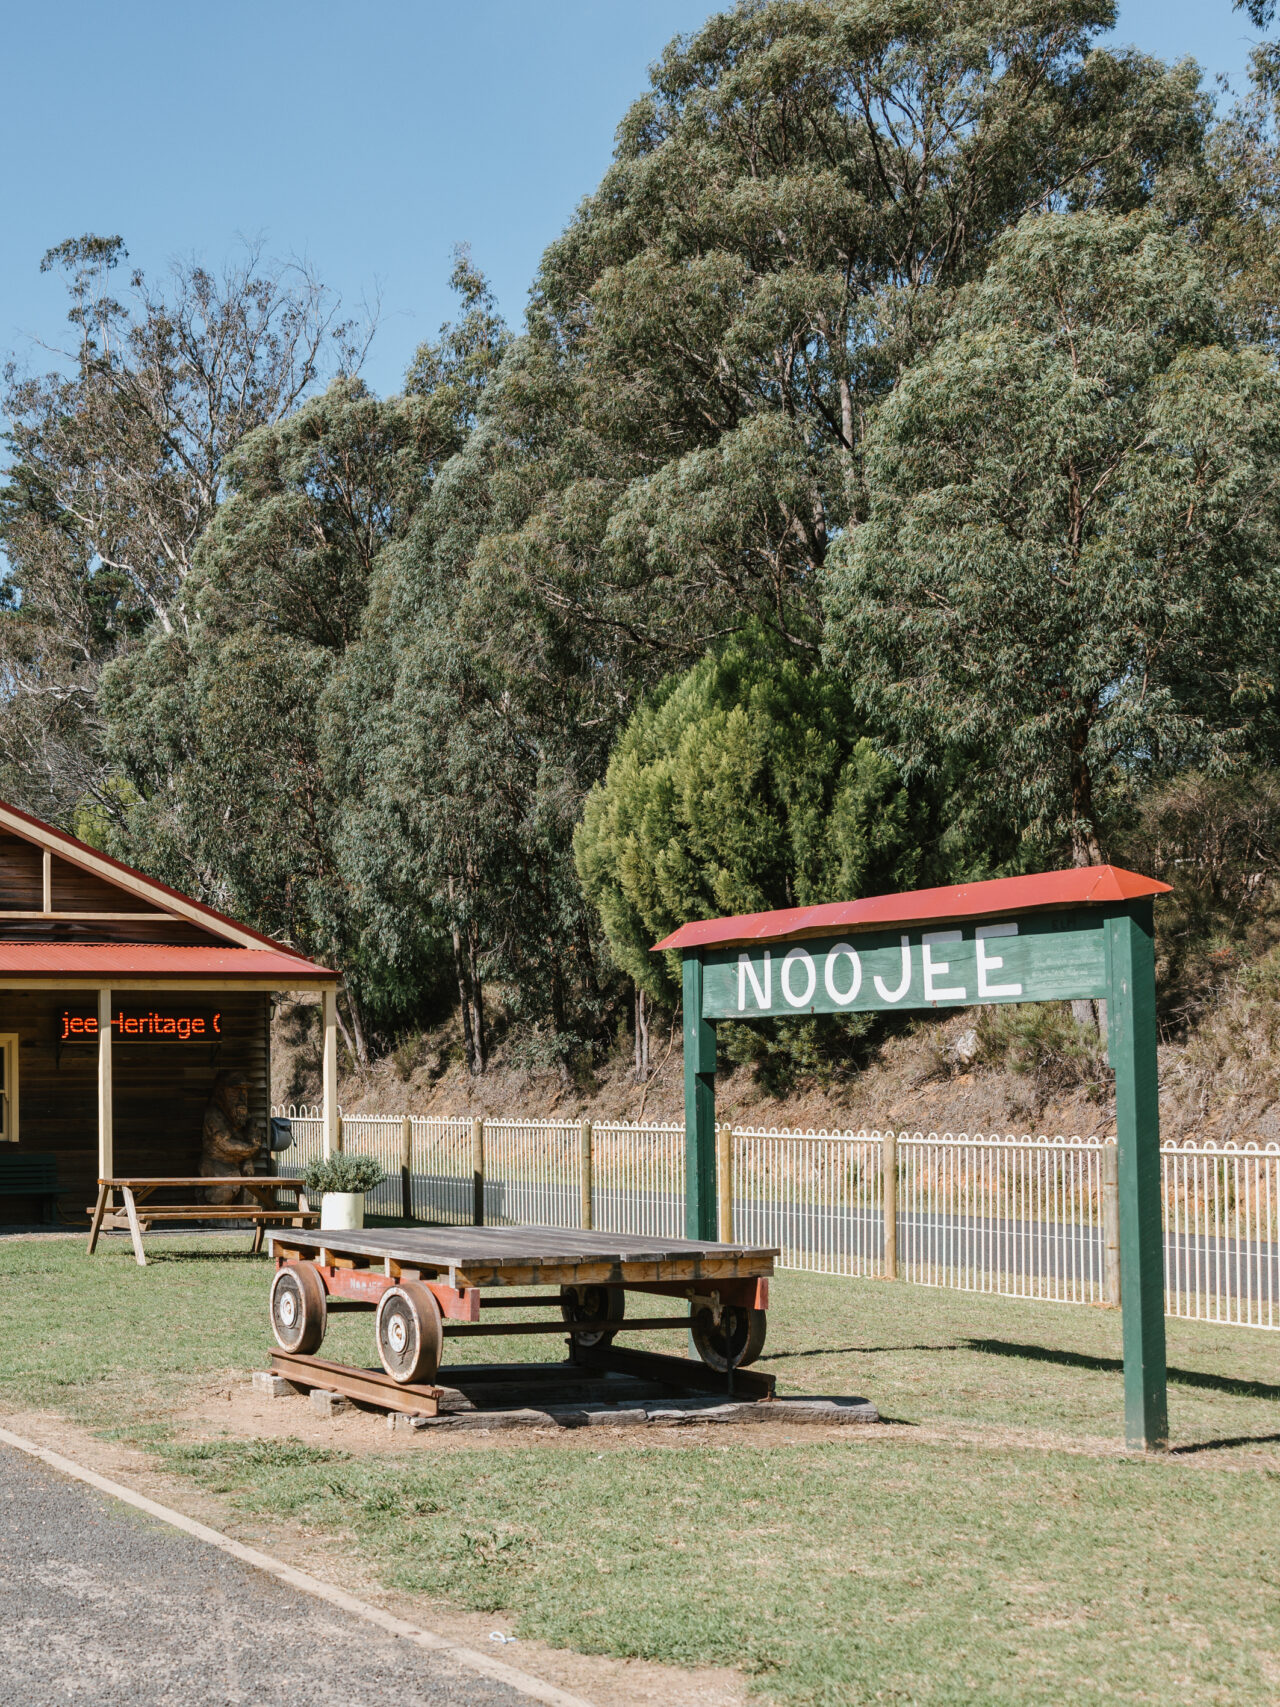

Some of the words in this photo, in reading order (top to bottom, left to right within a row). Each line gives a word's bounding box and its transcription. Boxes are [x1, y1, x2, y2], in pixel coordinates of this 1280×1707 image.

[737, 922, 1022, 1011] NOOJEE
[61, 1011, 98, 1039] jee
[110, 1012, 205, 1039] Heritage
